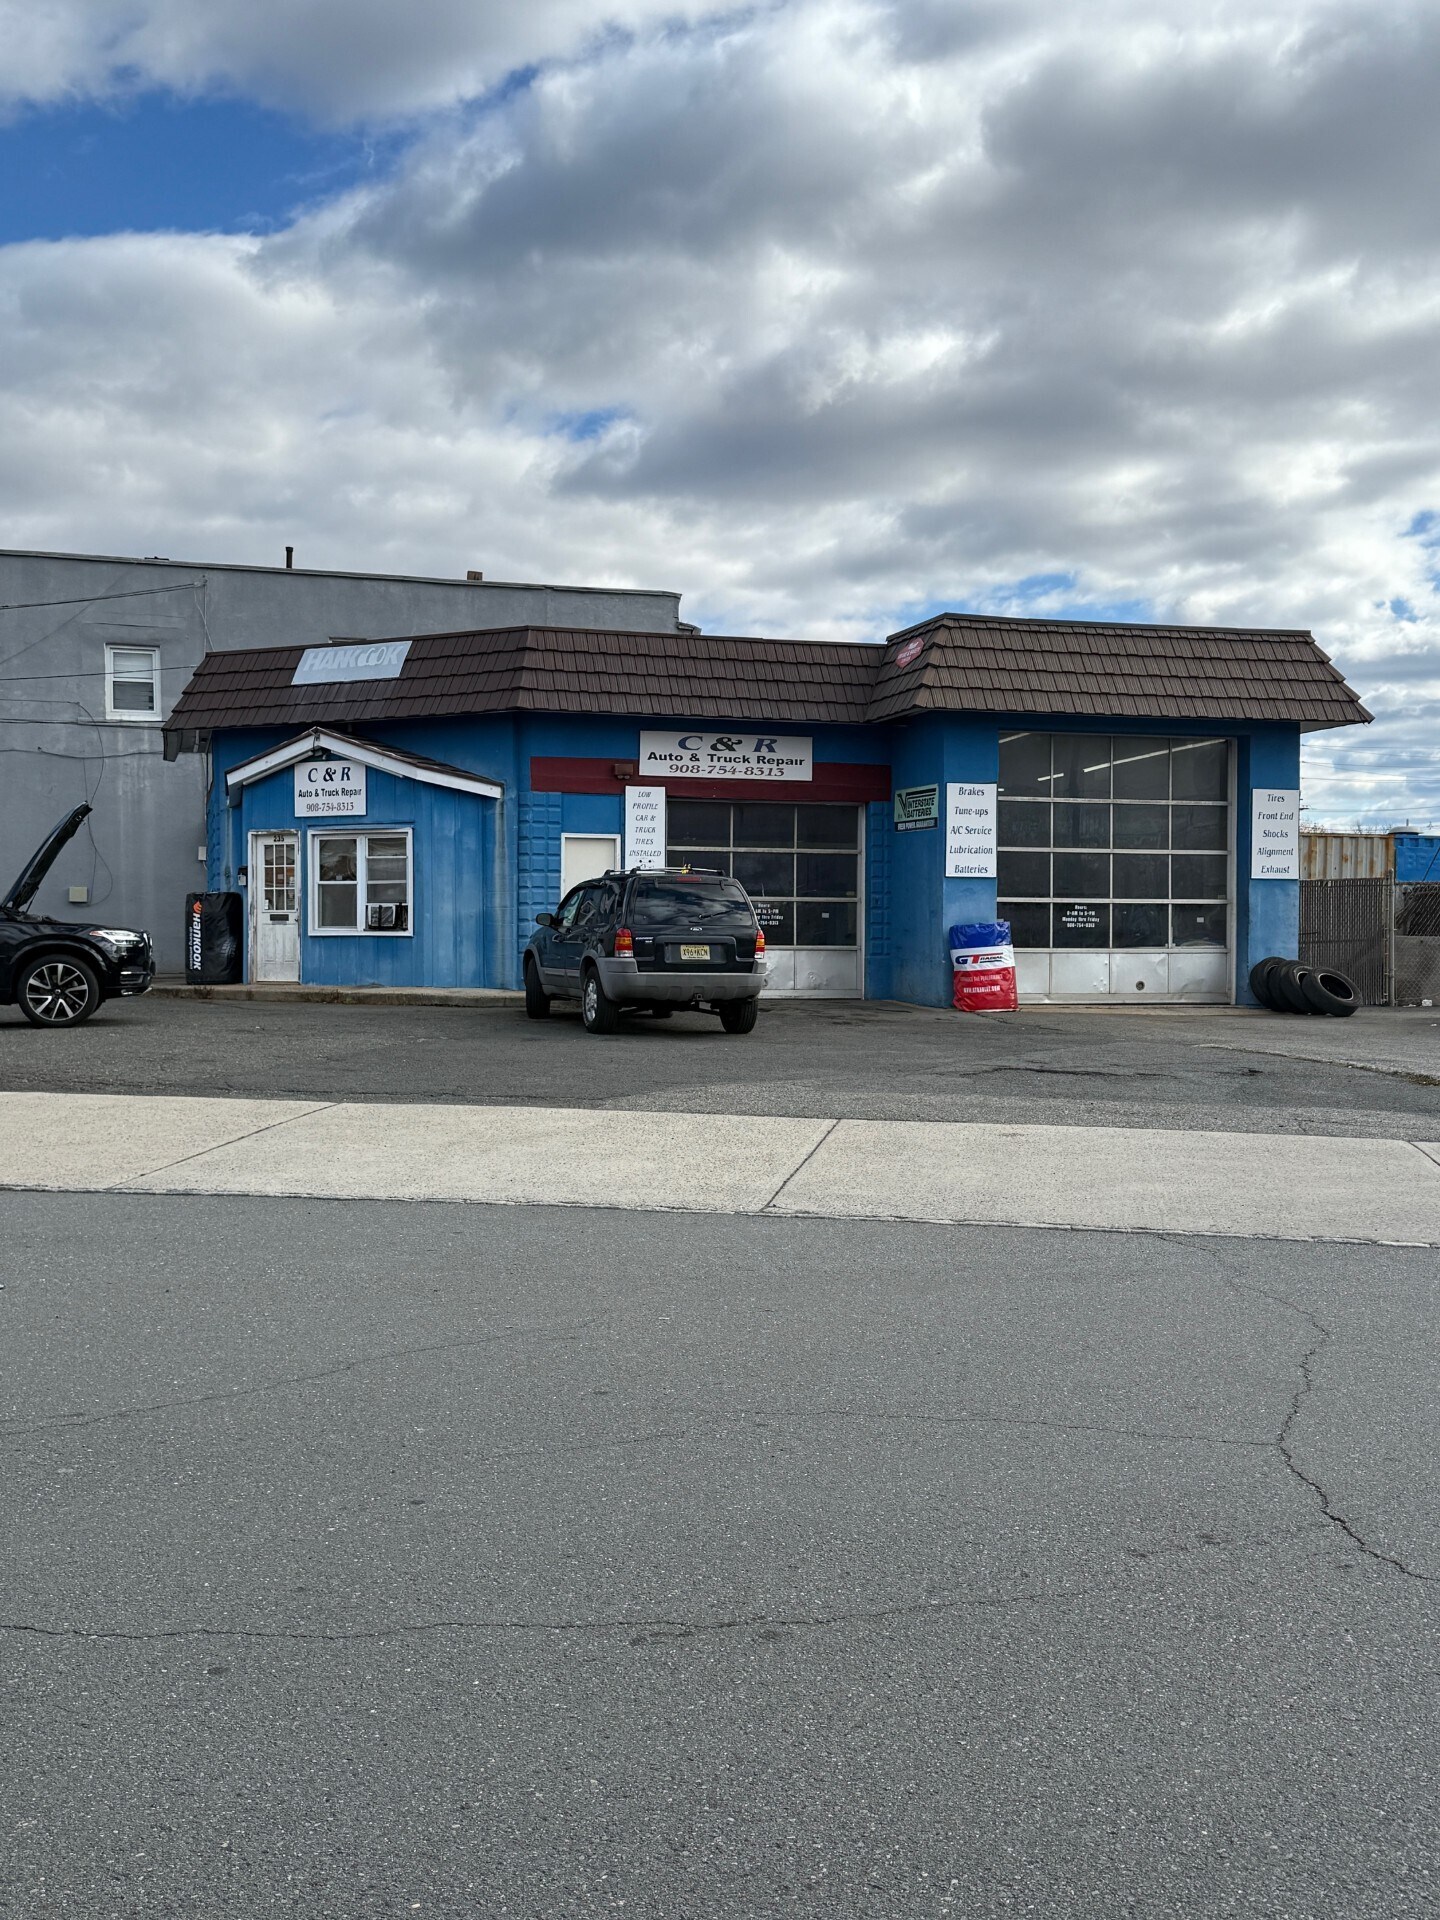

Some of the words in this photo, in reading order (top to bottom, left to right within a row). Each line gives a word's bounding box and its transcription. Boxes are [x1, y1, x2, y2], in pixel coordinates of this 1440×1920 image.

[678, 735, 704, 751] C
[710, 736, 743, 752] &
[753, 738, 778, 753] R
[647, 751, 684, 762] Auto
[689, 752, 701, 762] &
[707, 753, 751, 764] Truck
[757, 755, 806, 767] Repair
[307, 767, 319, 783] C
[323, 767, 337, 782] &
[340, 766, 351, 781] R
[669, 763, 786, 777] 908-754-8313
[298, 789, 313, 798] Auto
[314, 788, 320, 797] &
[321, 788, 340, 797] Truck
[341, 787, 362, 798] Repair
[958, 786, 985, 796] Brakes
[907, 797, 935, 809] INTERSTATE
[1267, 794, 1285, 802] Tires
[306, 801, 354, 812] 908-754-8313
[954, 806, 989, 817] Tune-ups
[906, 807, 932, 818] BATTERIES
[1257, 811, 1278, 820] Front
[1279, 812, 1294, 820] End
[950, 825, 964, 835] A/C
[965, 825, 992, 835] Service
[1262, 829, 1289, 838] Shocks
[949, 845, 993, 854] Lubrication
[1257, 847, 1294, 857] Alignment
[954, 864, 988, 874] Batteries
[1261, 865, 1290, 874] Exhaust
